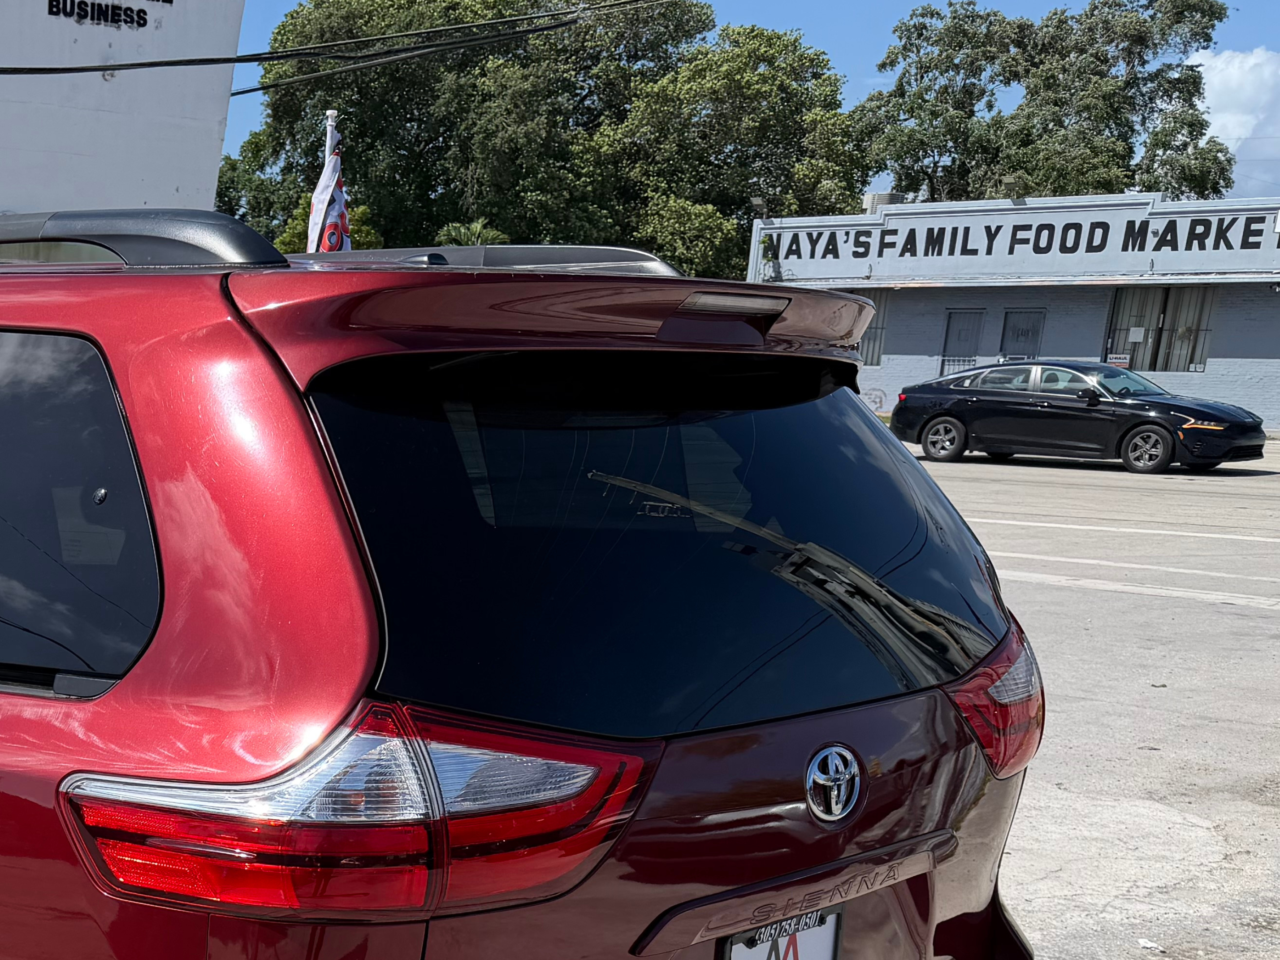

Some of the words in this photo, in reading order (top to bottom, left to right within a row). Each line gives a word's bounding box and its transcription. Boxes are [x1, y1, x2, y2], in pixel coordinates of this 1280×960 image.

[48, 0, 148, 28] BUSINESS
[877, 224, 1004, 259] FAMILY
[1007, 221, 1111, 256] FOOD
[1121, 215, 1280, 252] MARKE
[749, 863, 901, 925] SIENNA
